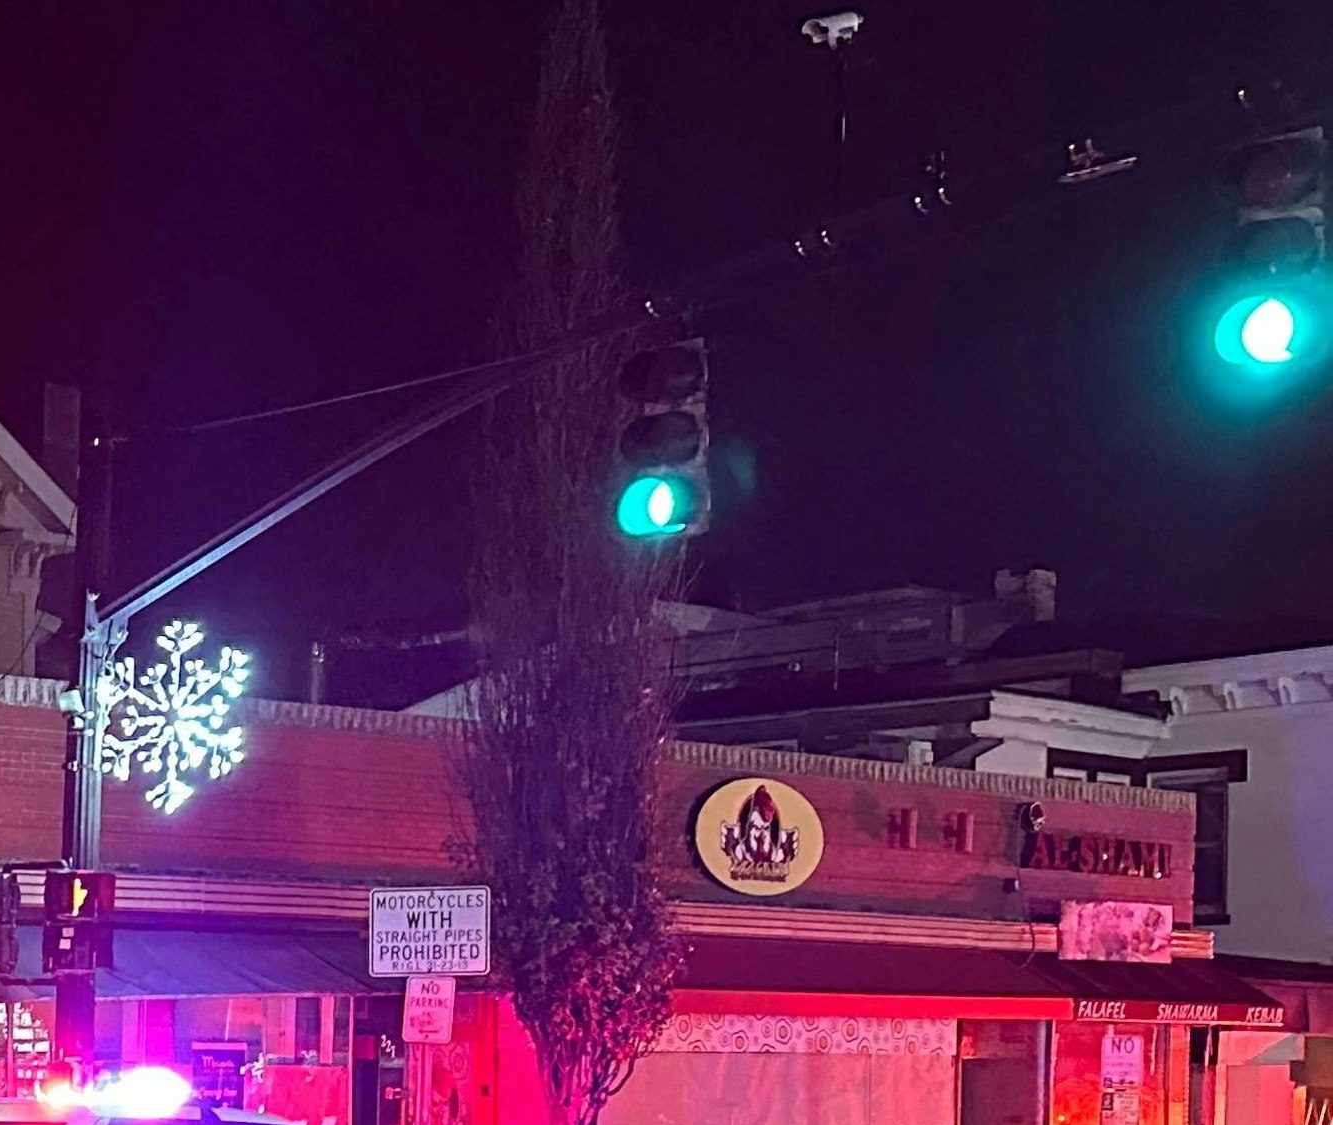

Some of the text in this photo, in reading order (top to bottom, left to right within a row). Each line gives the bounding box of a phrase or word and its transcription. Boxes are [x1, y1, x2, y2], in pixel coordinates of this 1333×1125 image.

[376, 894, 484, 910] MOTORCYCLES
[406, 911, 452, 929] WITH
[376, 929, 484, 944] STRAIGHT PIPES
[380, 943, 480, 961] PROHIBITED
[421, 982, 440, 995] NO
[1077, 1001, 1284, 1023] FALAFEL SHAWARMA KEBAB
[1111, 1037, 1135, 1054] NO
